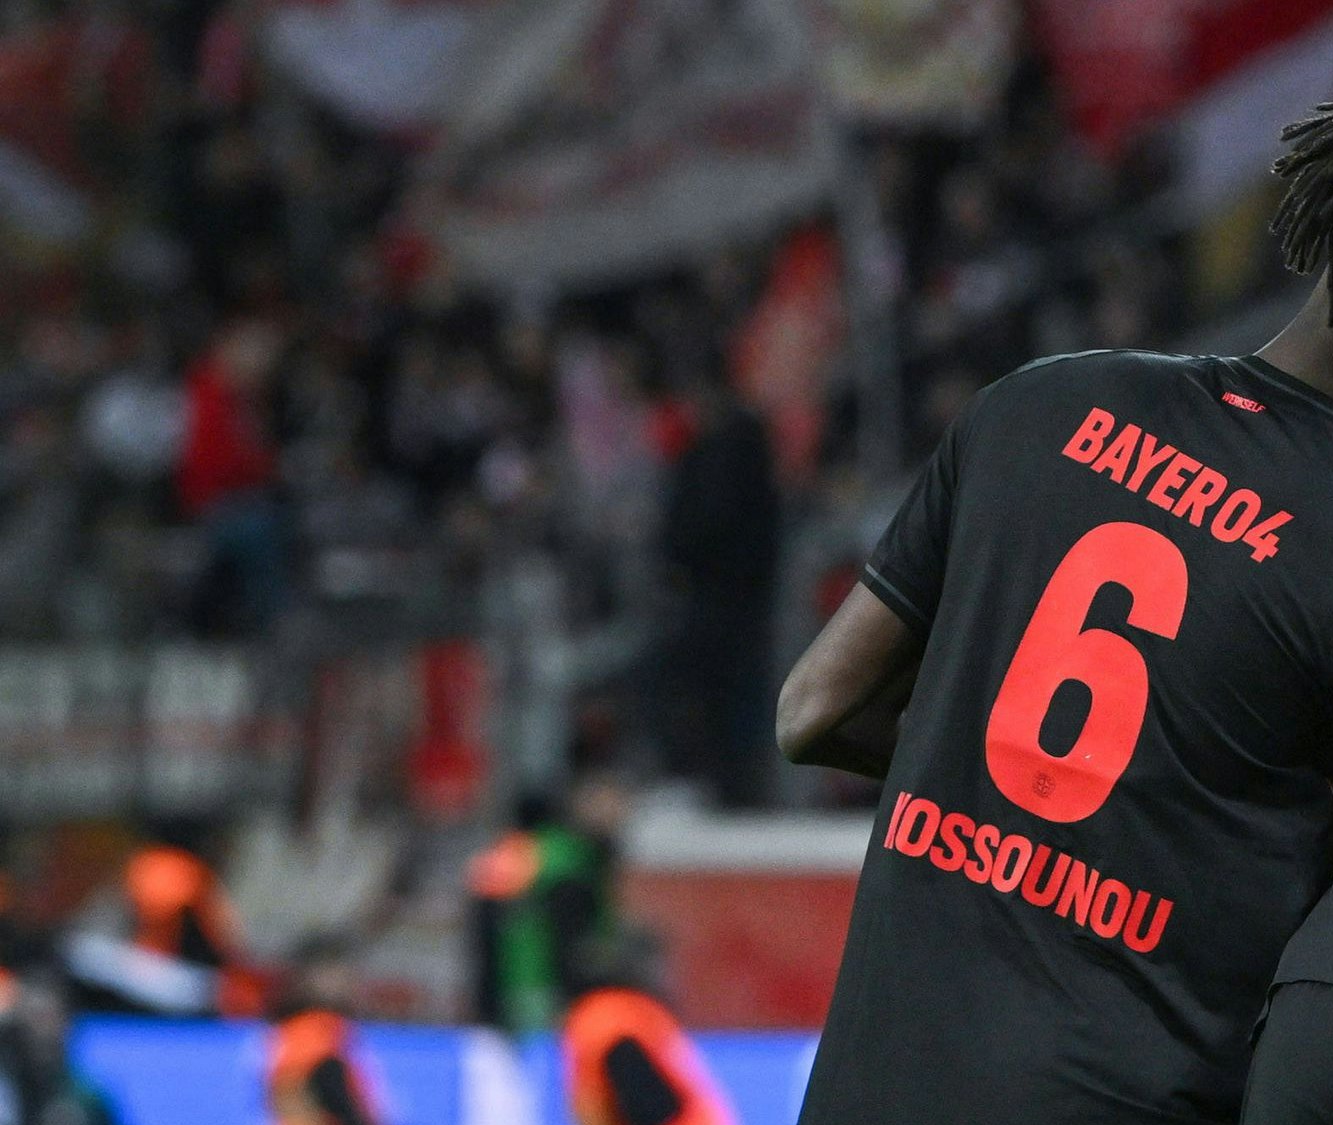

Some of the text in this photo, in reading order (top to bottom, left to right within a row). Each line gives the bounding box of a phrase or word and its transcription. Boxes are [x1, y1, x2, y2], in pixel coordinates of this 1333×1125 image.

[1062, 407, 1294, 564] BAYER04
[986, 521, 1188, 824] 6
[884, 790, 1175, 954] OSSOUNOU
